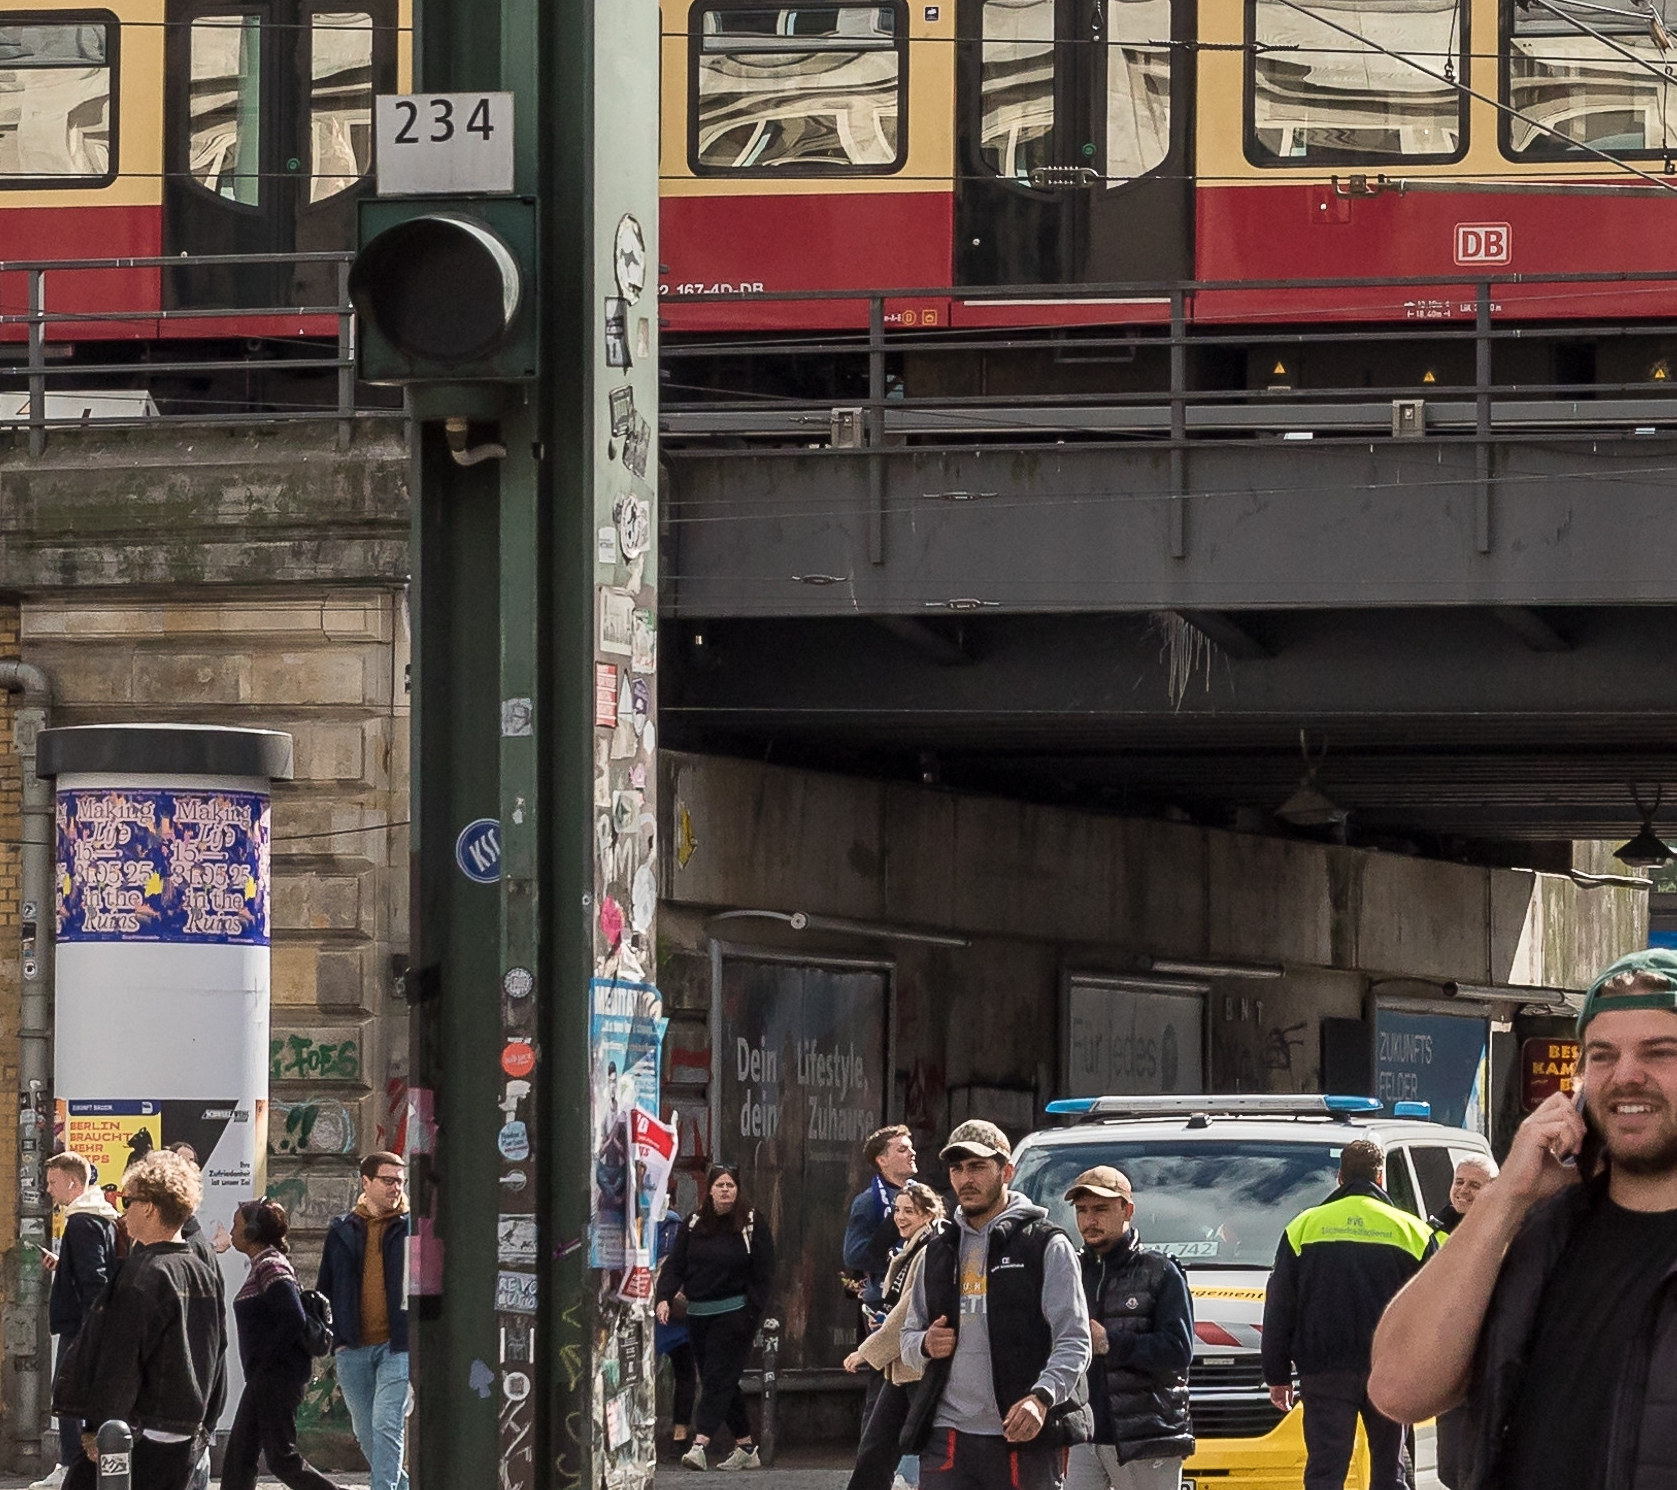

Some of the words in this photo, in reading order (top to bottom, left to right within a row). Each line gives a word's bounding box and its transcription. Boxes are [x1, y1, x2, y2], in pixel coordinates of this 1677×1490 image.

[394, 97, 495, 146] 234
[1460, 229, 1509, 260] DB
[78, 796, 155, 826] Making
[176, 796, 253, 829] Making
[83, 889, 103, 910] in
[105, 887, 143, 910] the
[187, 889, 210, 911] in
[212, 889, 245, 911] the
[83, 910, 141, 933] Ruins
[183, 911, 244, 934] Ruins
[1379, 1030, 1435, 1065] ZUKUNFTS
[1548, 1044, 1580, 1060] BES
[737, 1036, 779, 1083] Dein
[796, 1038, 868, 1090] Lifestyle,
[1531, 1061, 1577, 1077] KAM
[1379, 1071, 1420, 1102] FELDER
[740, 1088, 780, 1139] dein
[69, 1121, 120, 1131] BERLIN
[69, 1133, 132, 1143] BRAUCHT
[69, 1144, 104, 1154] MEHR
[85, 1154, 111, 1165] IPS
[1191, 1289, 1265, 1300] gement
